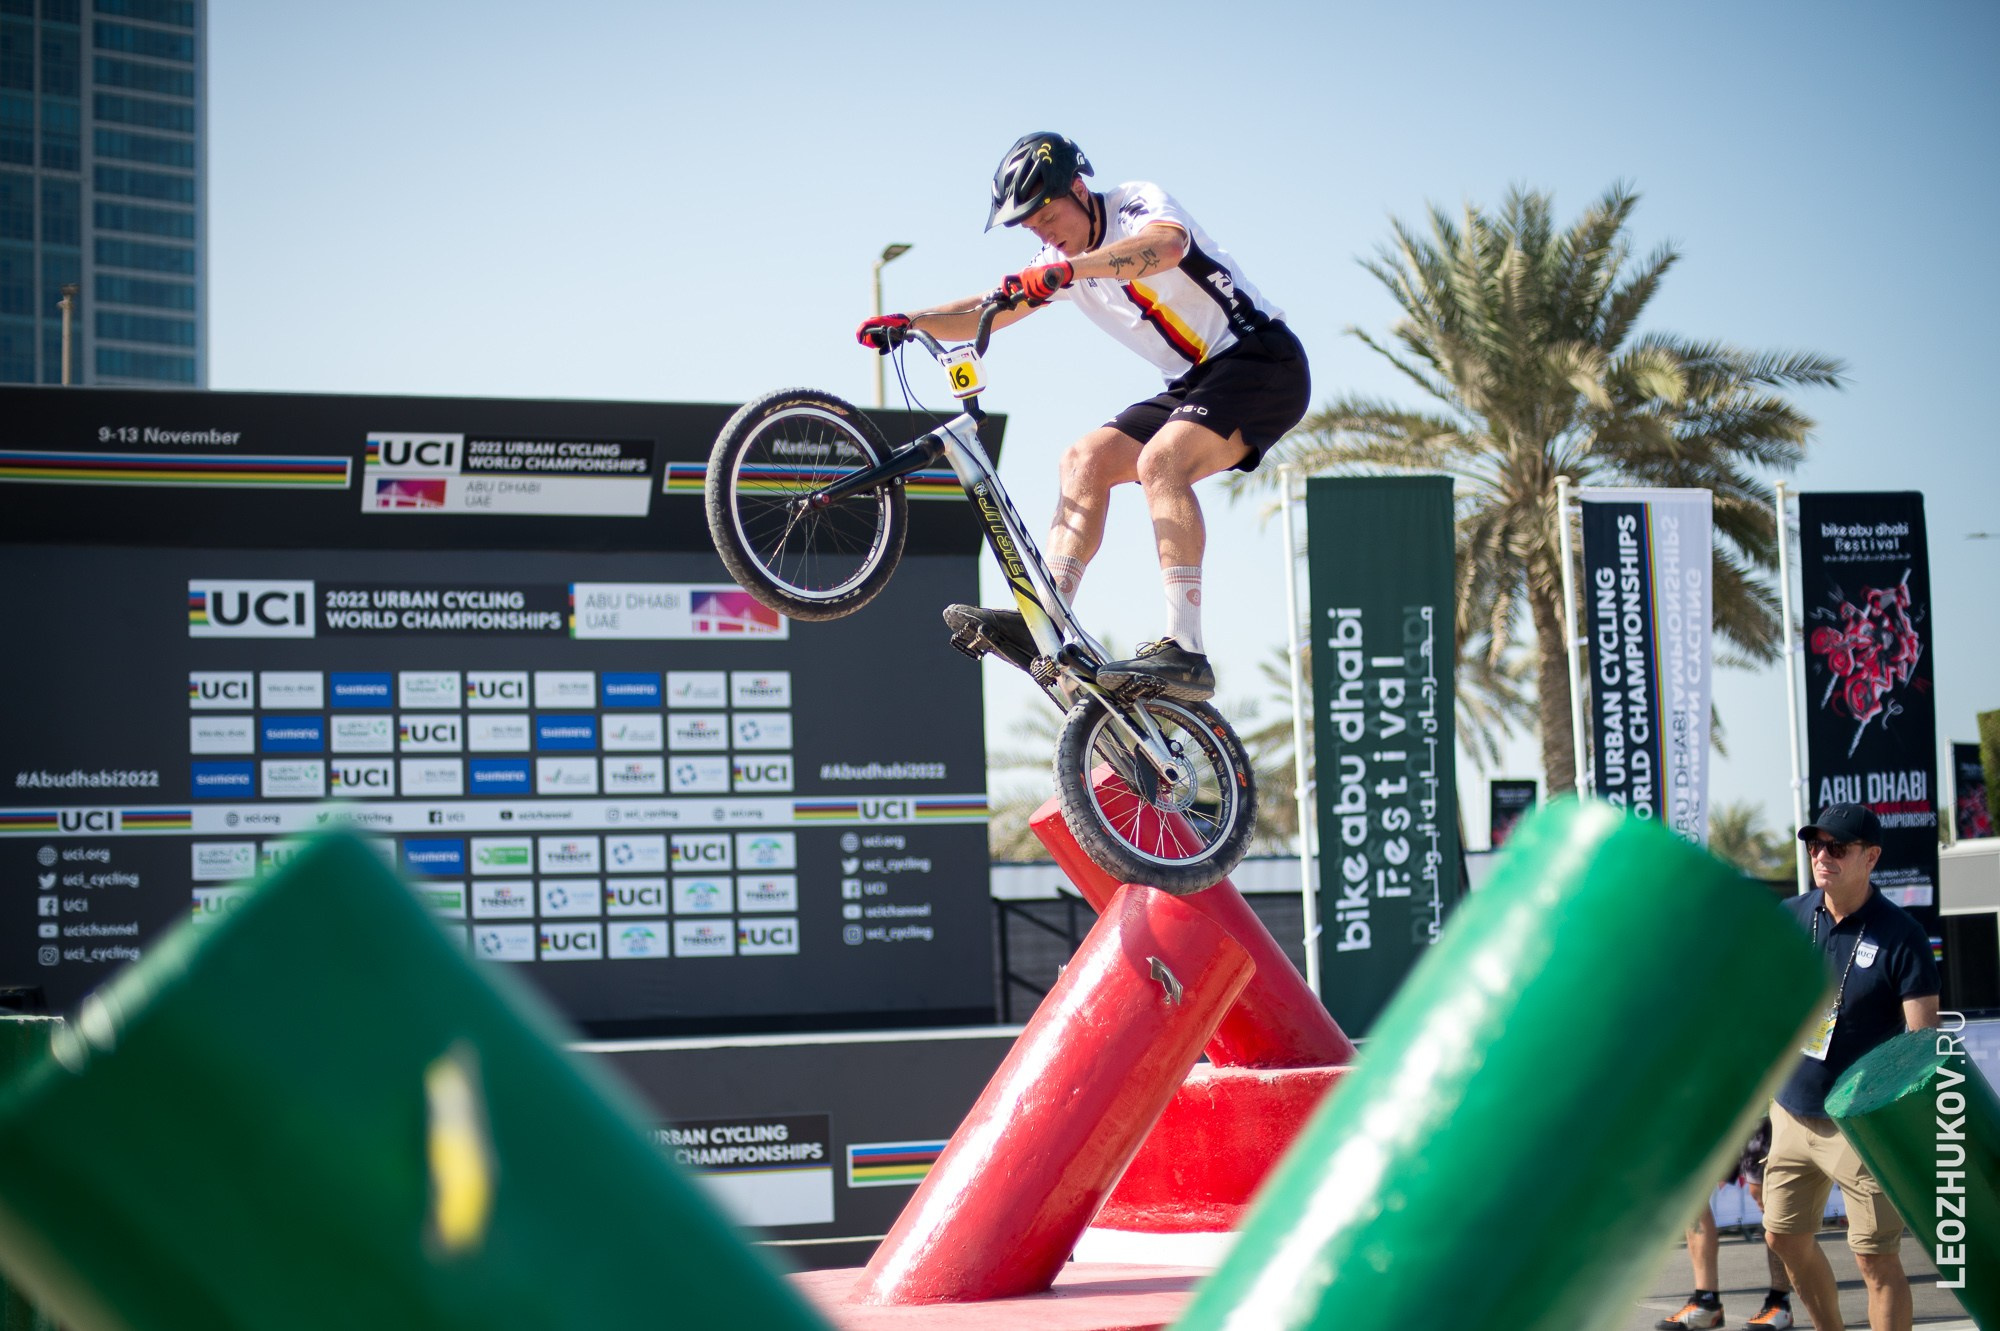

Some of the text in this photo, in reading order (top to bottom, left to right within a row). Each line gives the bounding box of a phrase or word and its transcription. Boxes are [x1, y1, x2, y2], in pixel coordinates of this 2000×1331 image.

[98, 426, 241, 446] 9-13 November
[382, 441, 454, 467] UCI
[469, 441, 621, 458] 2022 URBAN CYCLING
[771, 439, 831, 456] Nation
[468, 455, 648, 473] WORLD CHAMPIONSHIPS
[466, 480, 542, 495] ABU DHABI
[466, 494, 493, 509] UAE
[1821, 522, 1848, 538] bike
[1875, 521, 1909, 537] dhabi
[210, 590, 306, 627] UCI
[326, 591, 525, 610] 2022 URBAN CYCLING
[585, 592, 681, 610] ABU DHABI
[326, 610, 562, 630] WORLD CHAMPIONSHIPS
[585, 613, 621, 631] UAE
[1595, 566, 1622, 687] CYCLING
[1617, 513, 1654, 822] ORLD CHAMPIONSHIPS
[202, 681, 248, 699] UCI
[478, 681, 523, 699] UCI
[411, 724, 456, 742] UCI
[1601, 691, 1628, 787] URBAN
[1673, 709, 1689, 789] DHABI
[15, 769, 160, 788] #Abudhabi2022
[343, 769, 389, 787] UCI
[744, 765, 787, 783] UCI
[1327, 606, 1372, 952] bike abu dhabi
[1818, 769, 1928, 808] ABU DHABI
[862, 800, 909, 820] UCI
[60, 811, 115, 832] UCI
[1877, 812, 1937, 829] AMPIONSHIPS
[683, 843, 726, 862] UCI
[202, 896, 246, 915] UC
[618, 887, 662, 906] UCI
[552, 932, 597, 950] UCI
[750, 927, 793, 946] UCI
[710, 1124, 789, 1145] CYCLING
[676, 1142, 823, 1165] CHAMPIONSHIPS
